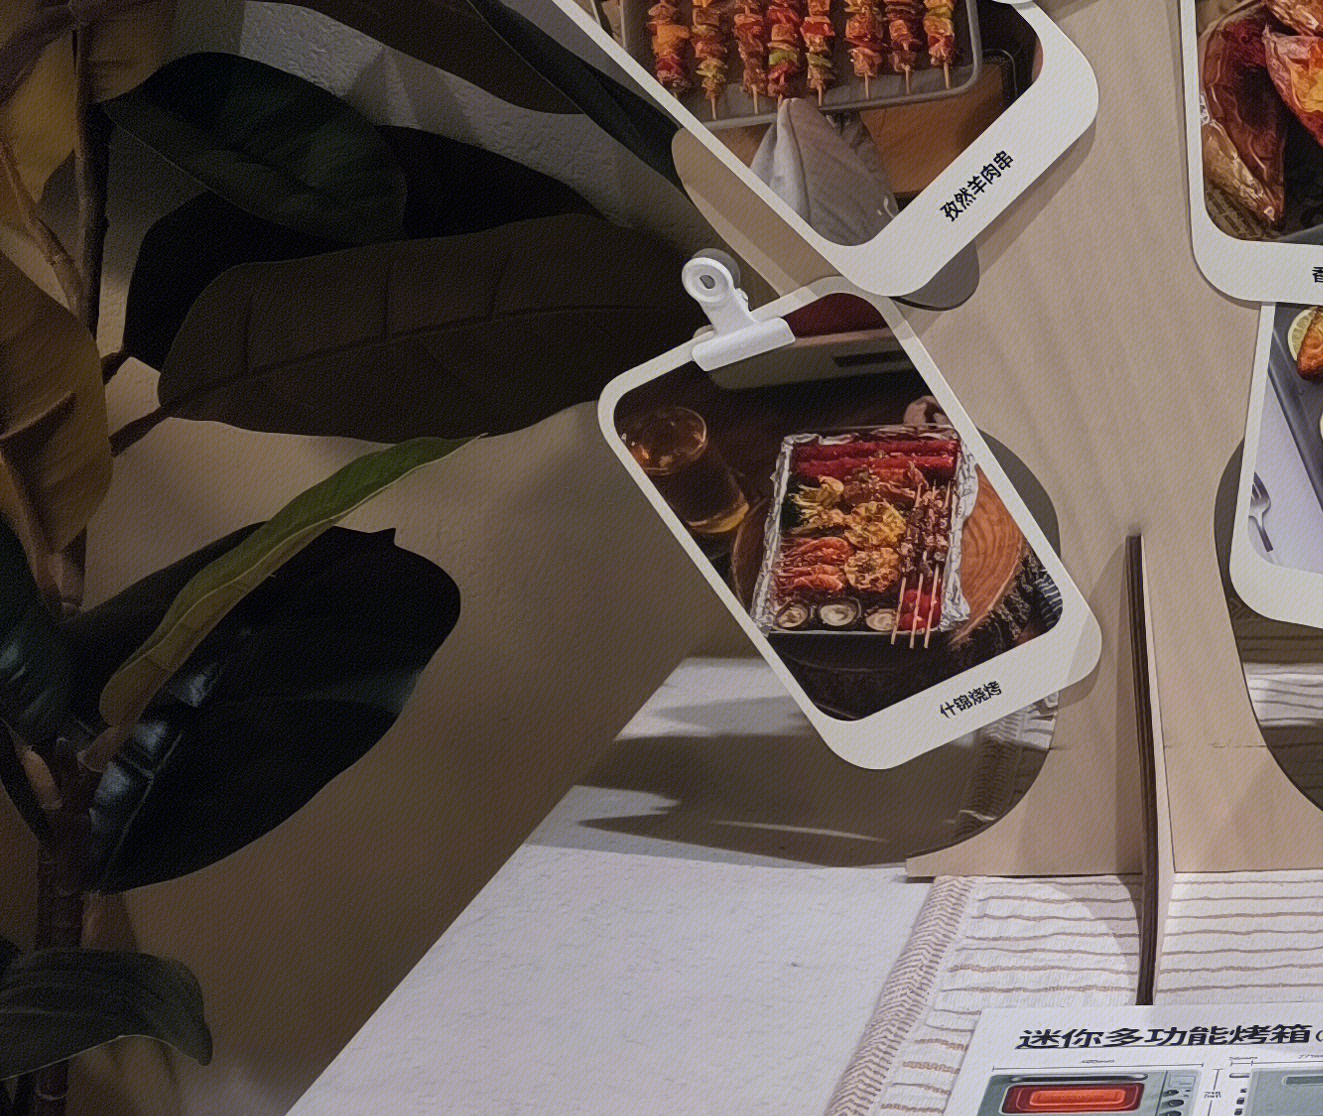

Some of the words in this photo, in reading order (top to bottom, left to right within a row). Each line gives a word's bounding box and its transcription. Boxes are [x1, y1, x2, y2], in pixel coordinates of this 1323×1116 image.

[939, 149, 1016, 222] 孜然羊肉串
[938, 679, 1003, 719] 什锦烧烤
[1015, 1024, 1314, 1051] 迷你多功能烤箱
